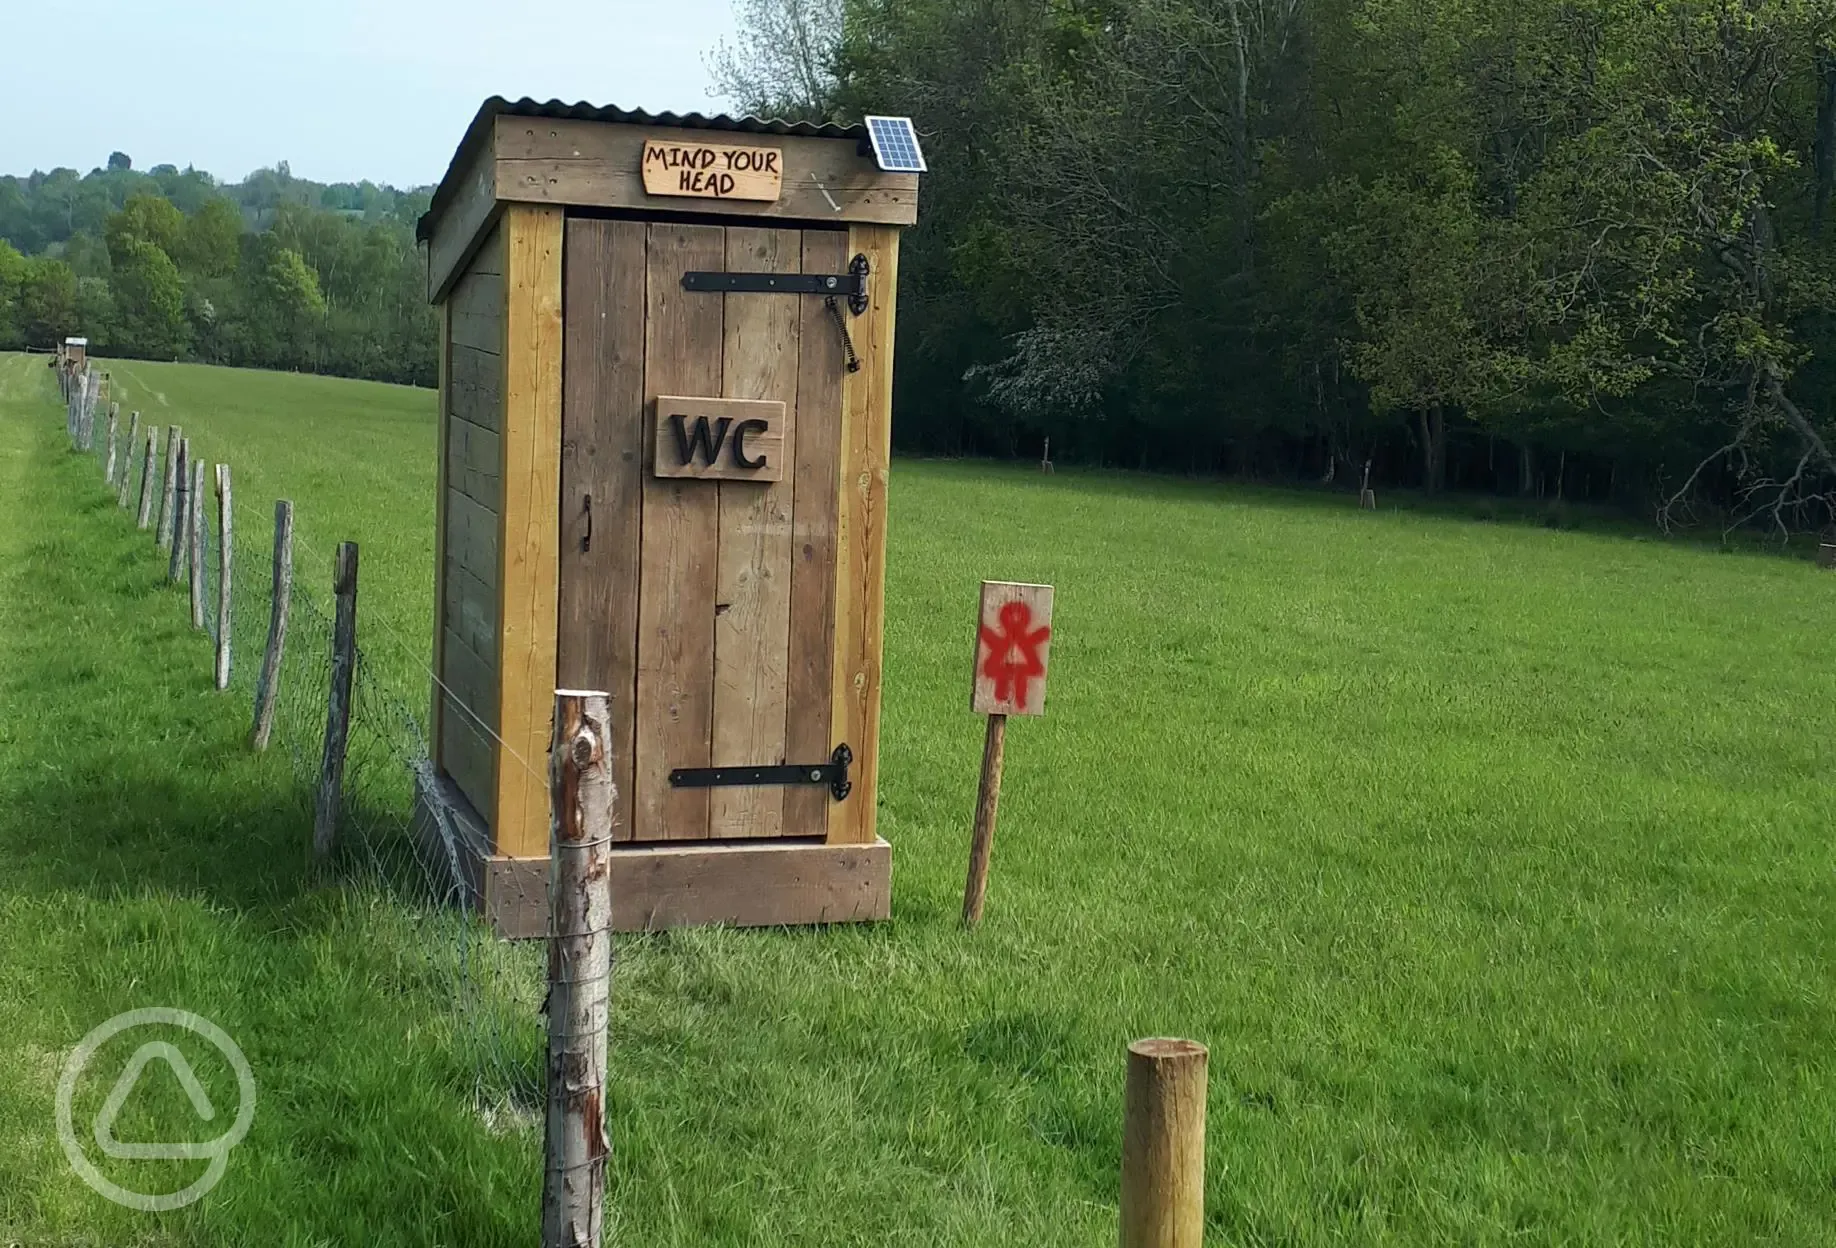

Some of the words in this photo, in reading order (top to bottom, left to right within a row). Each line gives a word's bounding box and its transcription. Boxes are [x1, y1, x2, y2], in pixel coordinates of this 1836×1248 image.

[646, 146, 716, 171] MIND
[722, 150, 778, 174] YOUR
[679, 170, 735, 197] HEAD
[668, 414, 769, 469] WC
